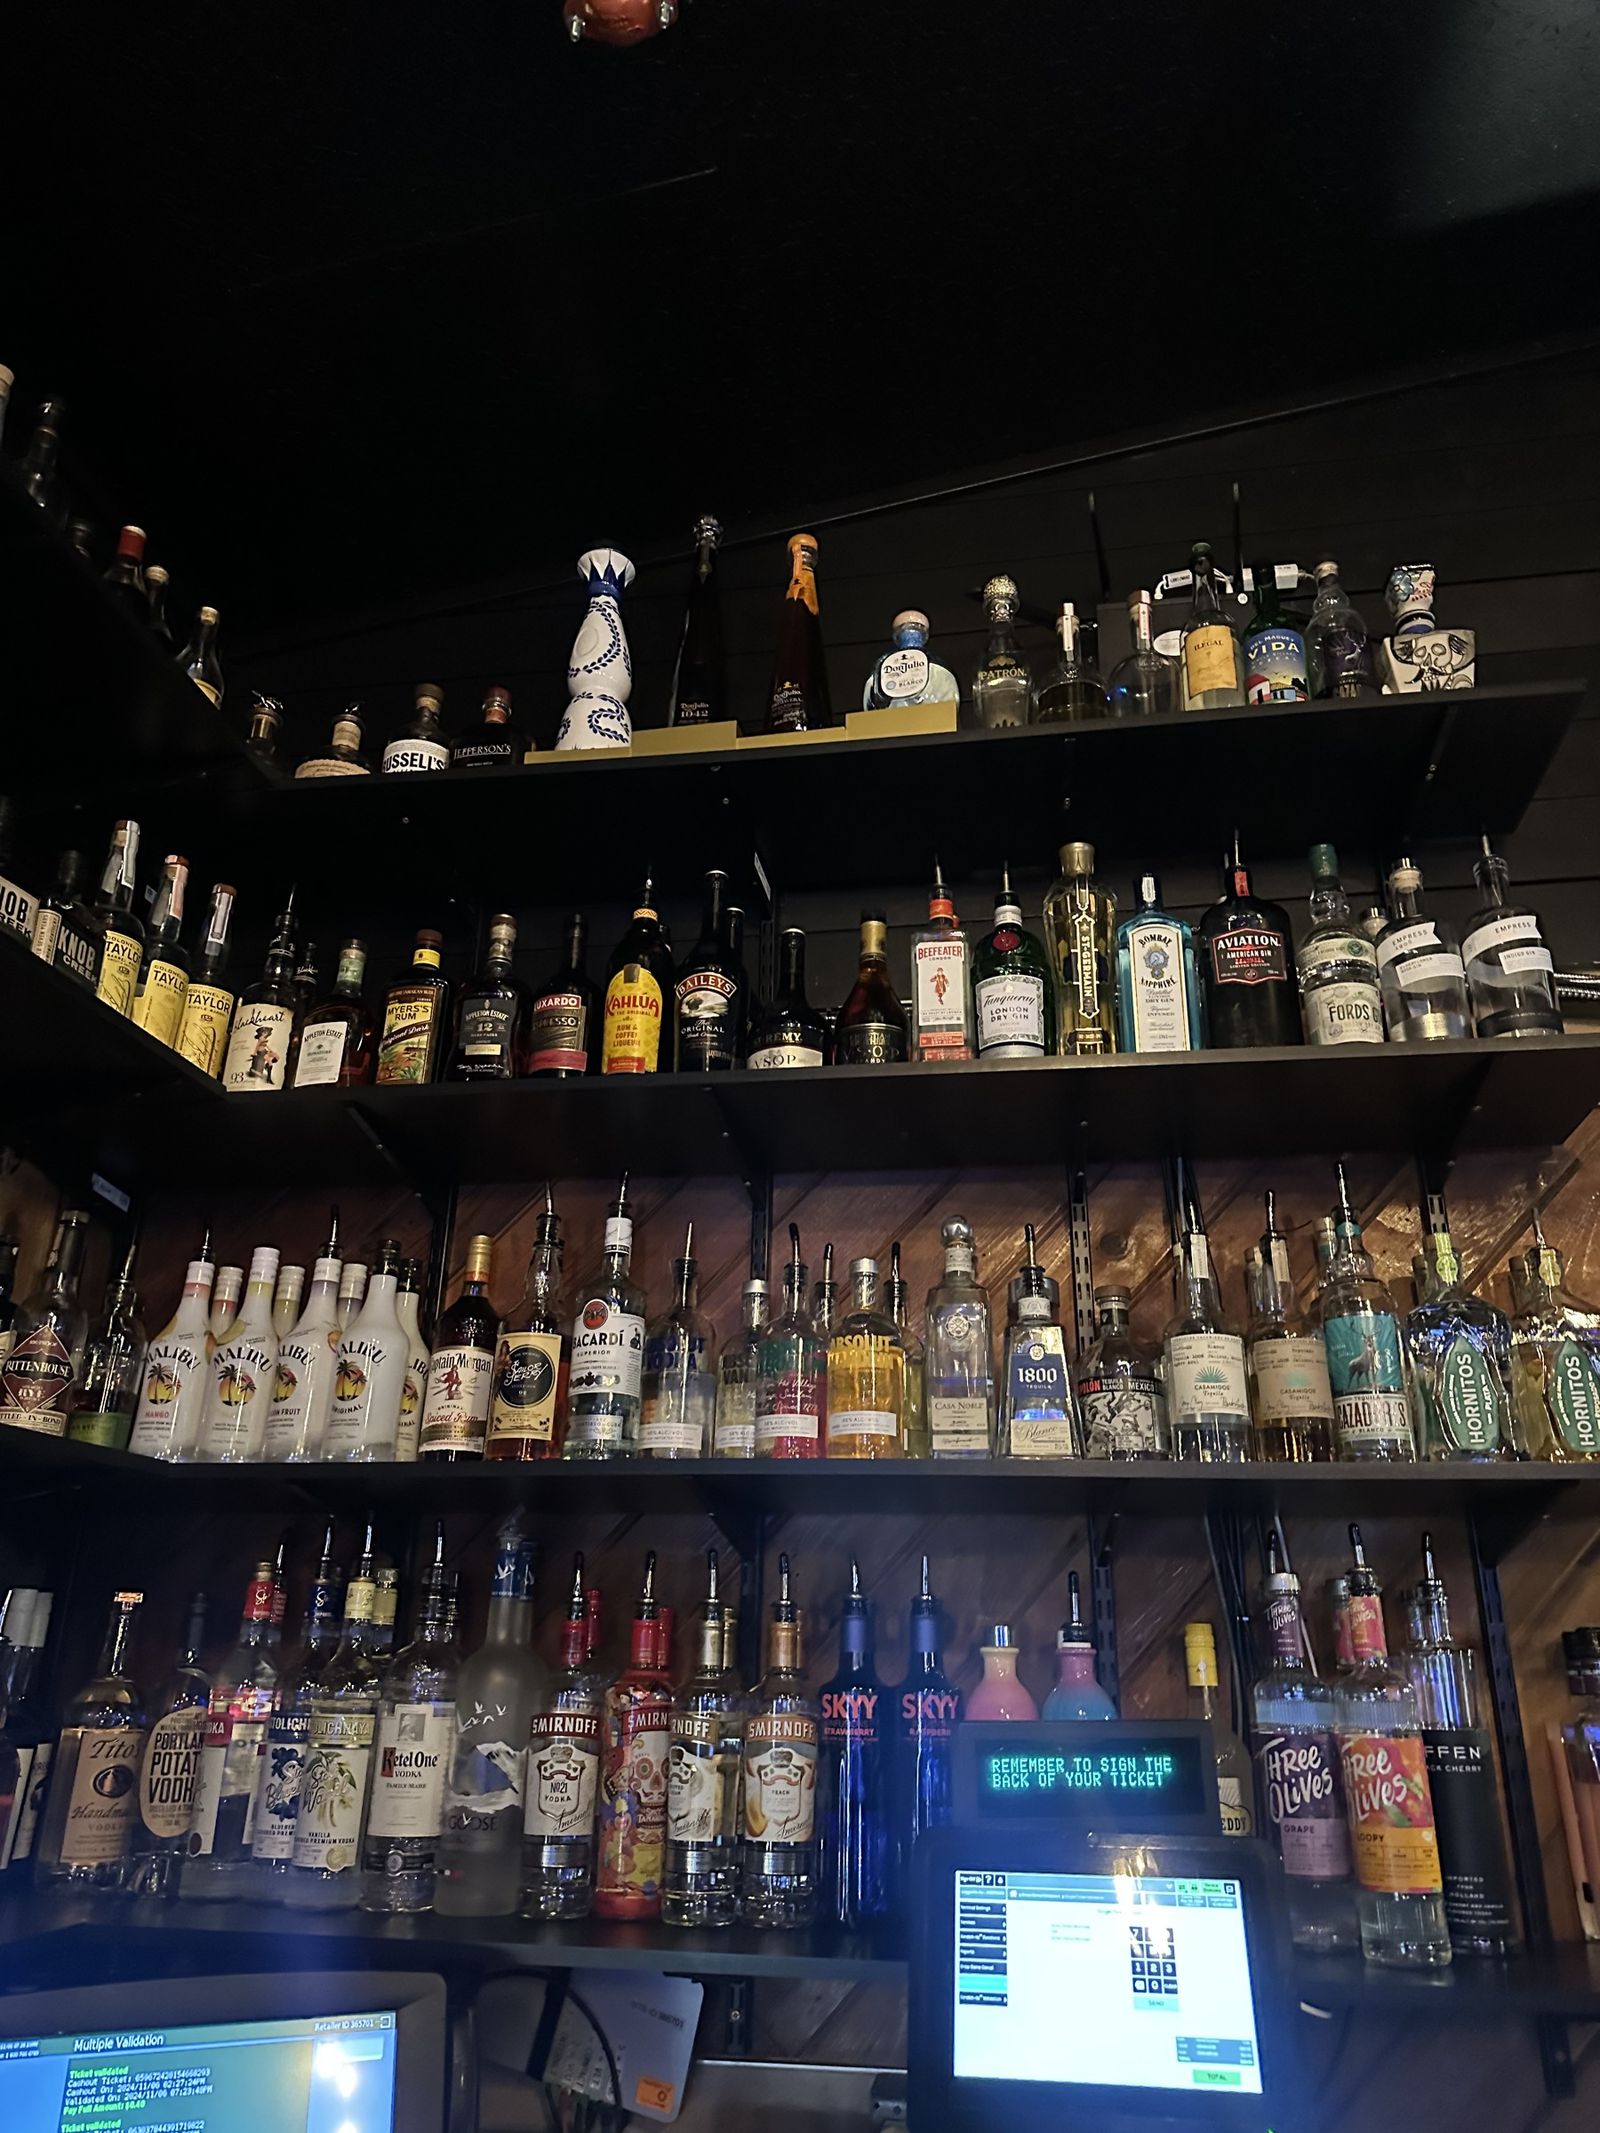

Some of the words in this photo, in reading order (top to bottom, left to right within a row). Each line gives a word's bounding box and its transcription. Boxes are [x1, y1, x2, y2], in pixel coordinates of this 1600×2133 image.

[1194, 640, 1224, 651] ILEGAL
[1248, 641, 1299, 660] VIDA
[454, 743, 512, 760] JEFFERSON'S
[1494, 922, 1532, 934] EMPRESS
[1138, 934, 1173, 949] BOMBAY
[1217, 934, 1280, 951] AVIATION
[1391, 929, 1429, 946] EMPRESS
[58, 924, 96, 971] KNOB
[917, 945, 963, 960] BEEFEATER
[1226, 951, 1259, 960] AMERICAN
[678, 974, 733, 997] BAILEYS
[1138, 974, 1178, 989] SAPPHIRE
[188, 993, 231, 1014] TAYLOR
[606, 991, 659, 1020] KAHLÚA
[983, 994, 1037, 1008] Tanqueray
[387, 1004, 430, 1016] MYERS'S
[394, 1012, 417, 1021] RUM
[490, 1010, 510, 1021] ESTATE
[990, 1006, 1029, 1016] LONDON
[990, 1013, 1008, 1023] DRY
[1012, 1012, 1029, 1021] GIN
[1328, 1003, 1369, 1022] FORDS
[476, 1022, 494, 1032] 12
[616, 1023, 631, 1032] RUM
[680, 1024, 725, 1035] ORIGINAL
[571, 1329, 624, 1348] BACARDÍ
[829, 1334, 890, 1352] ABSOLUT
[213, 1348, 274, 1373] MALIBU
[278, 1344, 315, 1367] ALIBU
[576, 1349, 611, 1357] SUPERIOR
[5, 1359, 72, 1378] RITTENHOUSE
[1017, 1367, 1058, 1384] 1800
[1128, 1382, 1156, 1393] MEXICO
[1194, 1383, 1230, 1391] CASAMIGOS
[1456, 1353, 1486, 1444] HORNITOS
[1482, 1384, 1492, 1411] PLATA
[1564, 1355, 1595, 1446] HORNITOS
[281, 1407, 302, 1416] FRUIT
[934, 1401, 958, 1411] CASA
[957, 1401, 984, 1411] NOBLE
[145, 1410, 170, 1419] MANGO
[424, 1411, 454, 1425] Spiced
[453, 1410, 479, 1424] Rum
[1023, 1425, 1058, 1443] Blanco
[821, 1693, 879, 1719] SKYY
[901, 1693, 959, 1719] SKYY
[532, 1716, 598, 1736] SMIRNOFF
[749, 1721, 815, 1740] SMIRNOFF
[382, 1747, 413, 1776] Ketel
[413, 1750, 438, 1770] One
[992, 1757, 1065, 1773] REMEMBER
[1073, 1757, 1092, 1772] TO
[1100, 1757, 1136, 1772] SIGN
[1144, 1756, 1173, 1772] THE
[1444, 1764, 1482, 1773] CHERRY
[394, 1769, 422, 1778] VODKA
[992, 1772, 1030, 1788] BACK
[1038, 1772, 1057, 1787] OF
[1065, 1772, 1103, 1787] YOUR
[1112, 1771, 1164, 1787] TICKET
[544, 1794, 572, 1804] VODKA
[771, 1788, 791, 1796] PEACH
[1283, 1824, 1315, 1834] GRAPE
[310, 1837, 337, 1845] PREMIUM
[338, 1837, 355, 1845] VODKA
[315, 2021, 341, 2032] Retailer
[342, 2021, 349, 2030] ID
[74, 2035, 114, 2052] Multiple
[116, 2033, 164, 2048] Validation
[70, 2070, 95, 2079] Ticket
[68, 2078, 97, 2087] Cashout
[66, 2086, 97, 2096] Cashout
[65, 2095, 105, 2106] Validated
[63, 2107, 78, 2117] Pay
